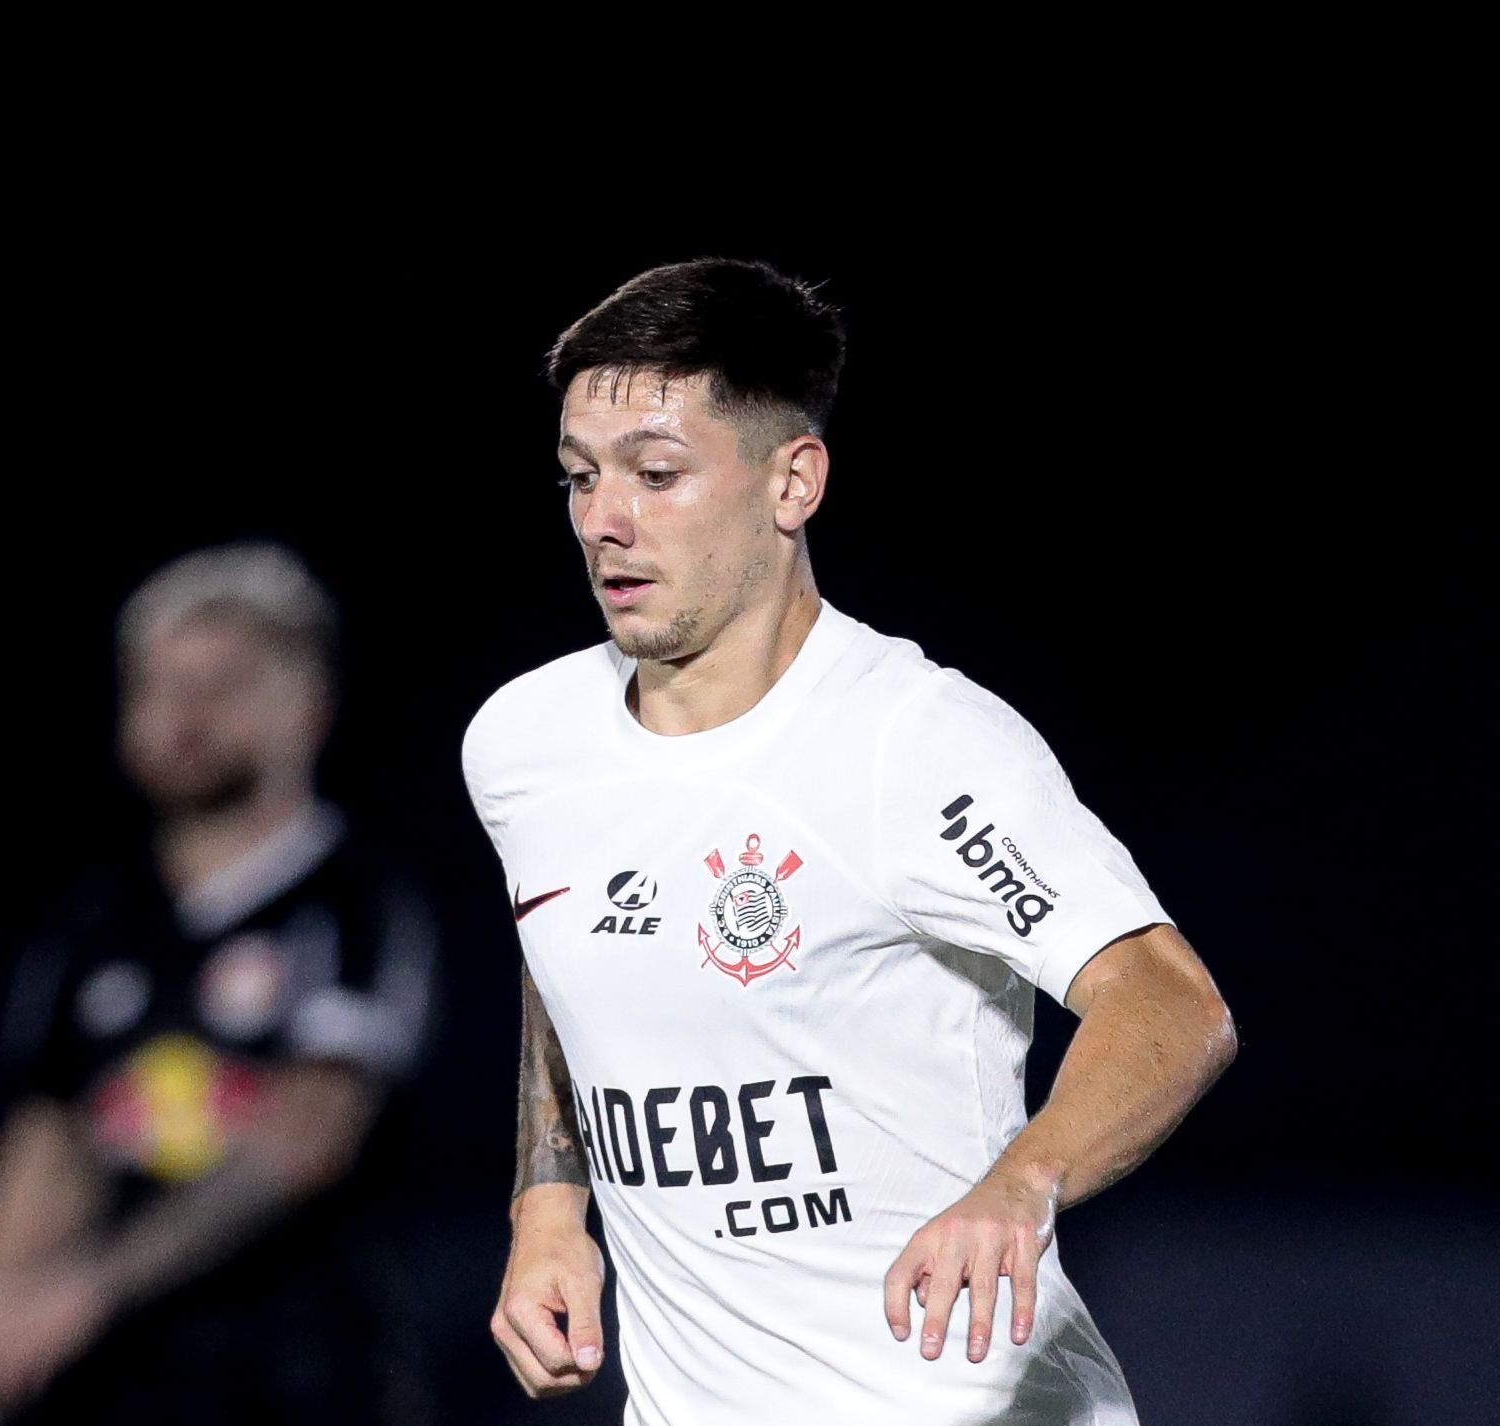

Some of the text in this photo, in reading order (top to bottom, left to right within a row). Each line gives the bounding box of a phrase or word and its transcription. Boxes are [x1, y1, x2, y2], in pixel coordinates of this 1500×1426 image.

[956, 823, 1054, 938] bmg
[1001, 836, 1060, 898] CORINTHIANS
[590, 915, 662, 935] ALE
[736, 938, 759, 948] 1910
[714, 1187, 853, 1239] .COM
